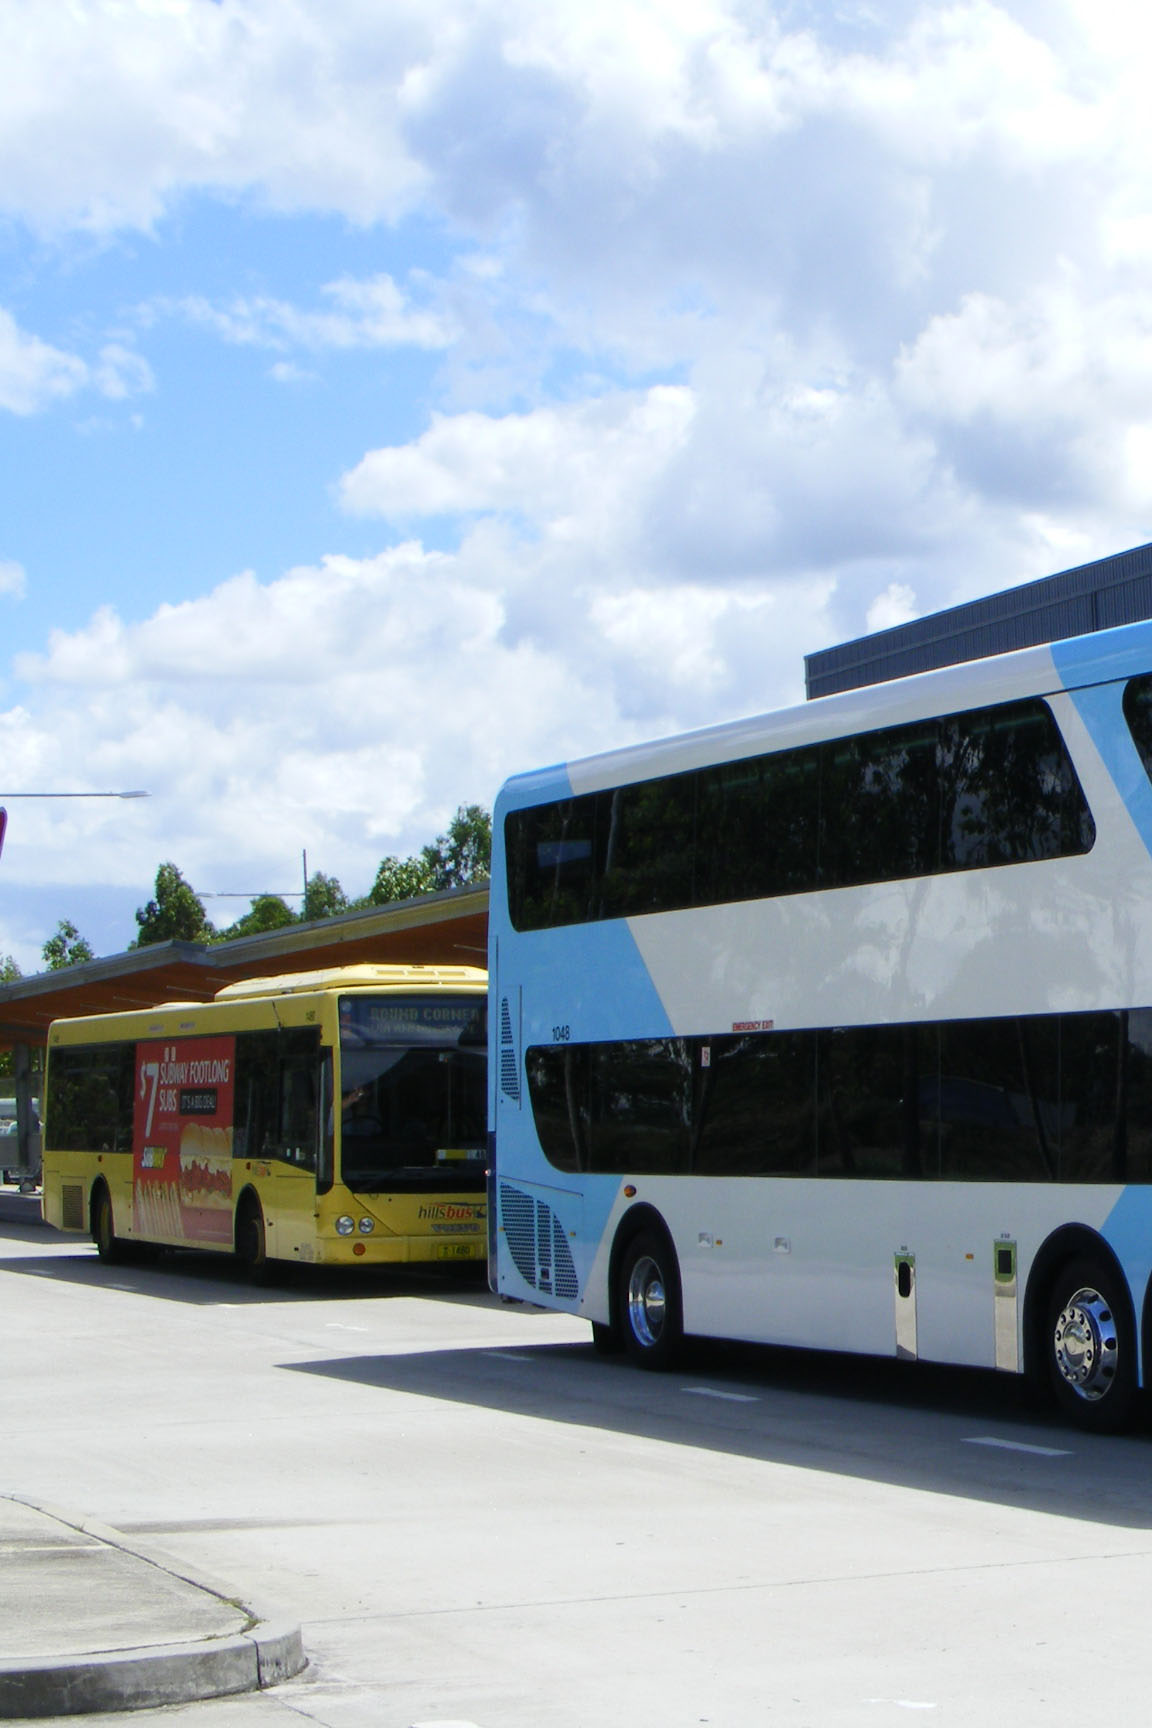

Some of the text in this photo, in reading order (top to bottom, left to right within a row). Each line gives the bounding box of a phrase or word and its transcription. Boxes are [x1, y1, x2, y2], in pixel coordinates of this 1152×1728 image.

[552, 1025, 570, 1042] 1048
[160, 1088, 177, 1112] SUBS
[418, 1205, 473, 1219] hillsbus
